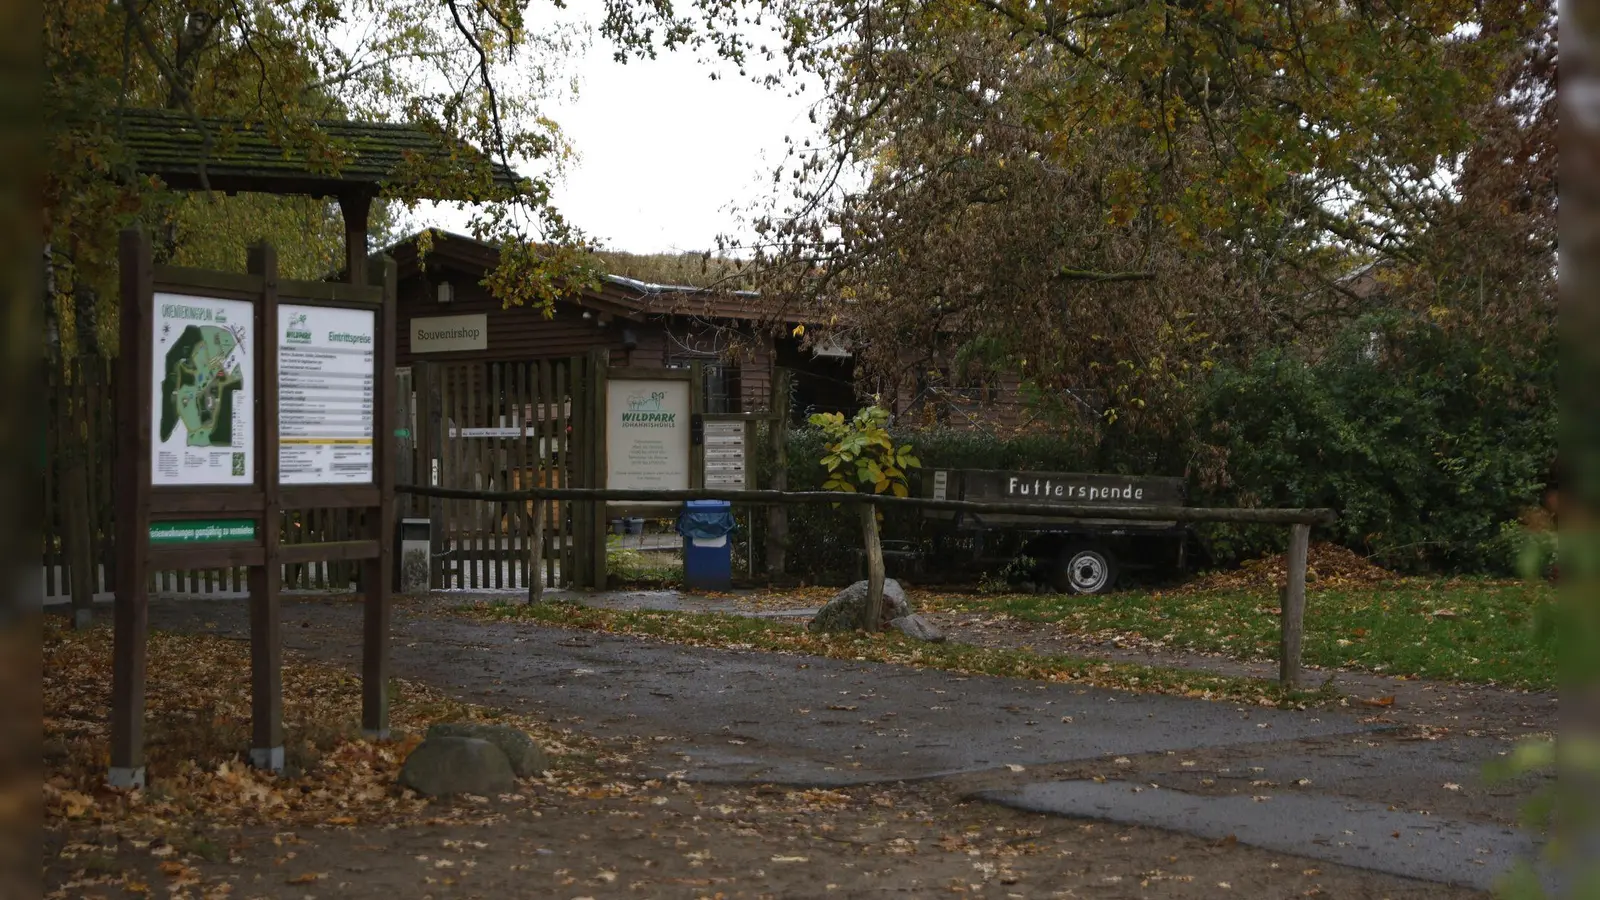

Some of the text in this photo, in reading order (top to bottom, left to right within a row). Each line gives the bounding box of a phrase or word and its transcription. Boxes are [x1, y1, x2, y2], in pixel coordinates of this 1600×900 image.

[328, 331, 372, 344] Eintrittspreise
[417, 326, 480, 341] Souvenirshop
[622, 412, 676, 422] WILDPARK
[1009, 477, 1144, 501] Futterspende
